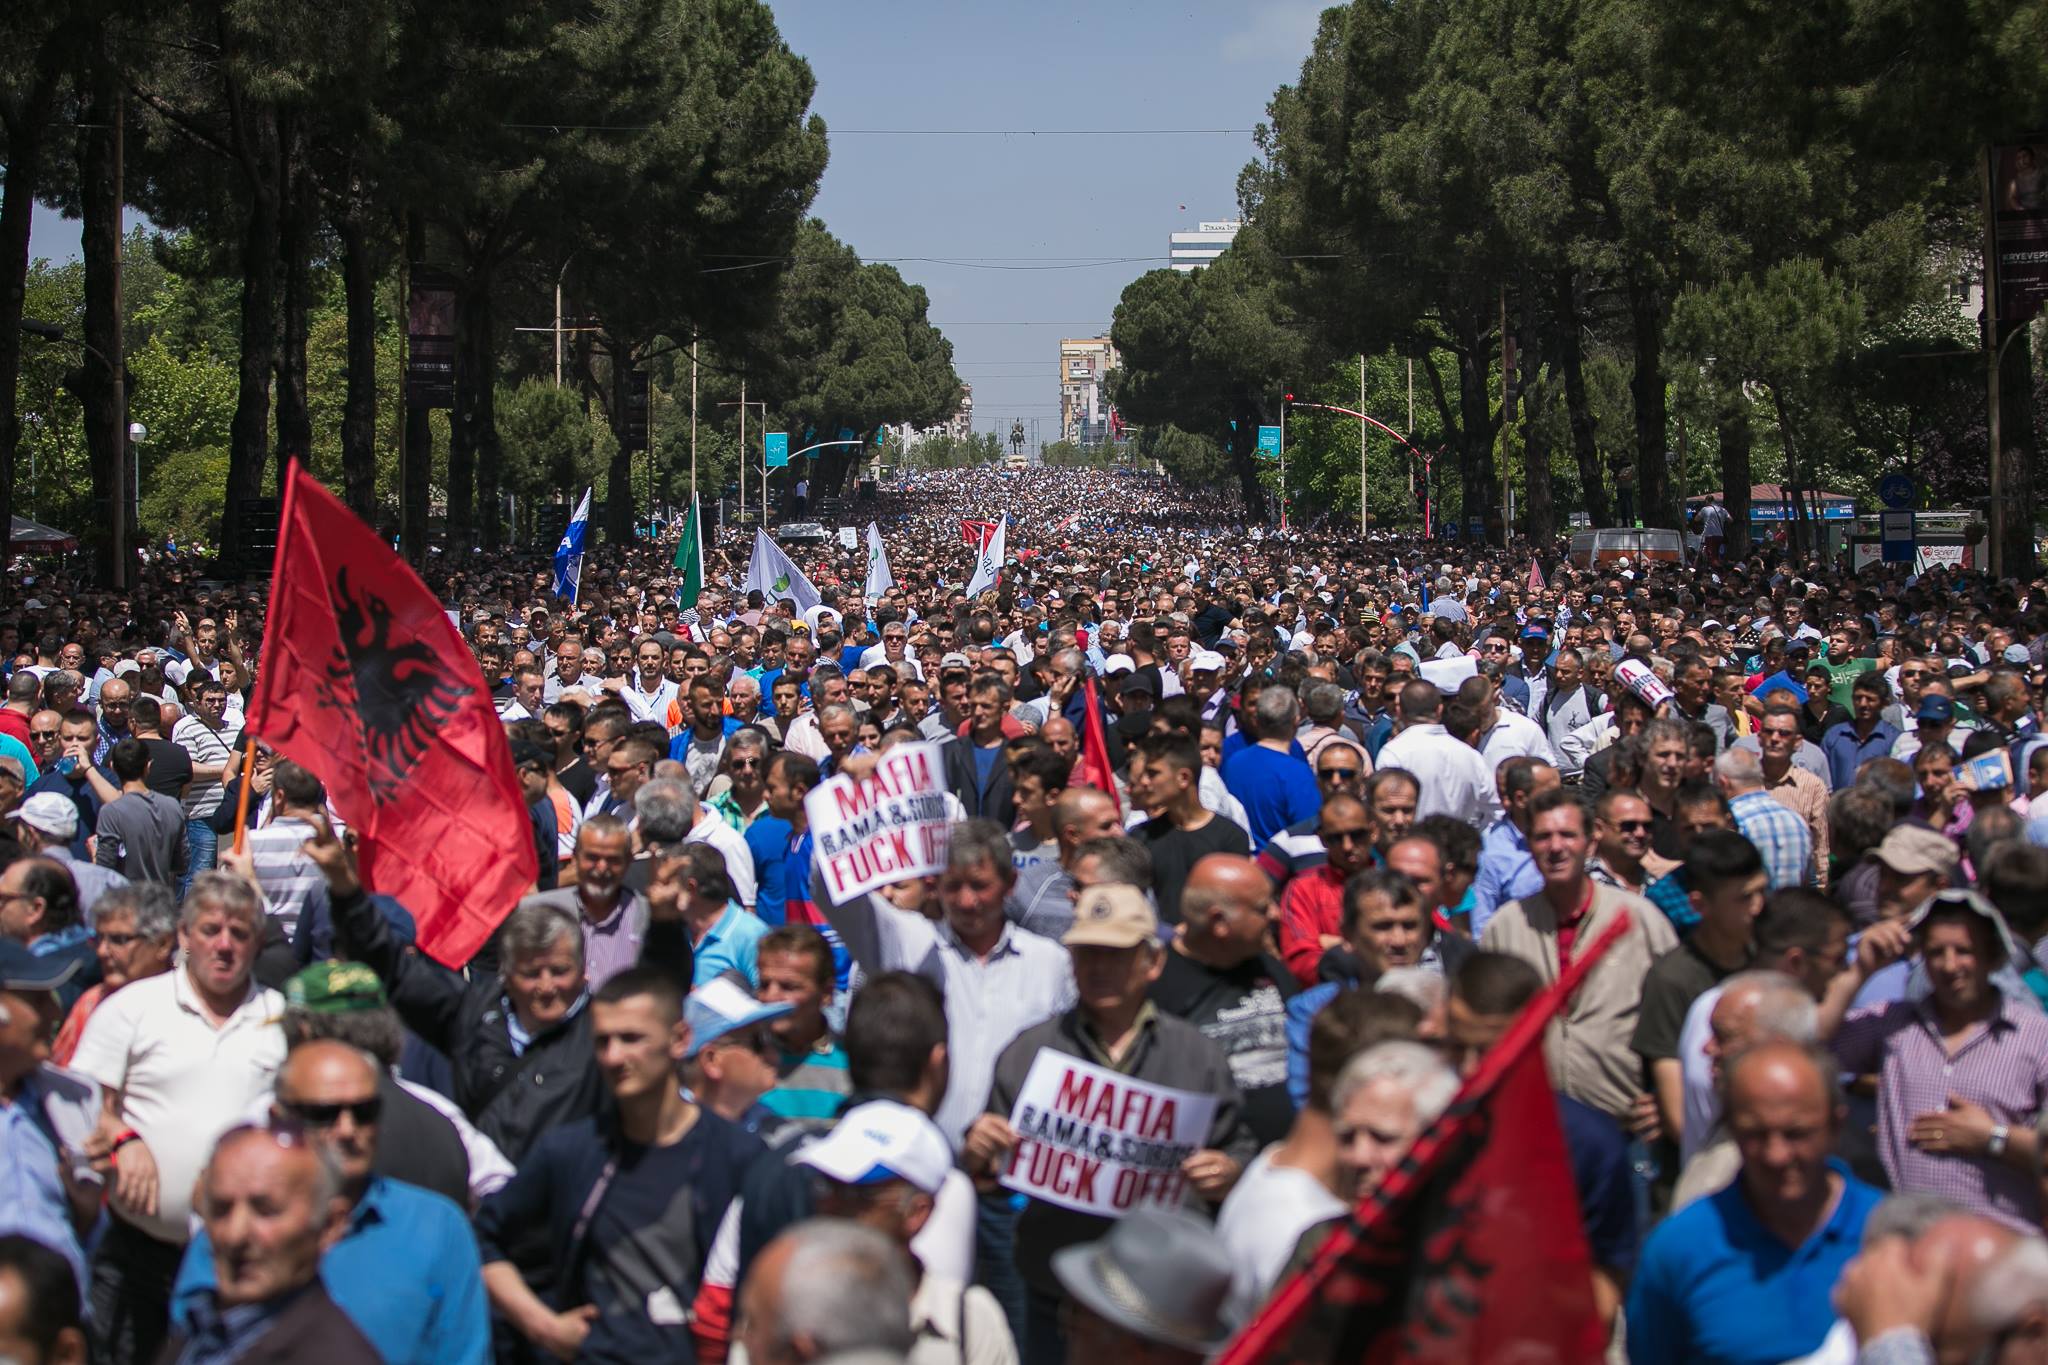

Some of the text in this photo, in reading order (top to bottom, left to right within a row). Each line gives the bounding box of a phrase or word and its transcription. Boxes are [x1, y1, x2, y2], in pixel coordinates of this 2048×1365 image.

[834, 753, 934, 821] MAFIA
[831, 829, 914, 892] FUCK
[1055, 1069, 1177, 1141] MAFIA
[1007, 1138, 1102, 1204] FUCK
